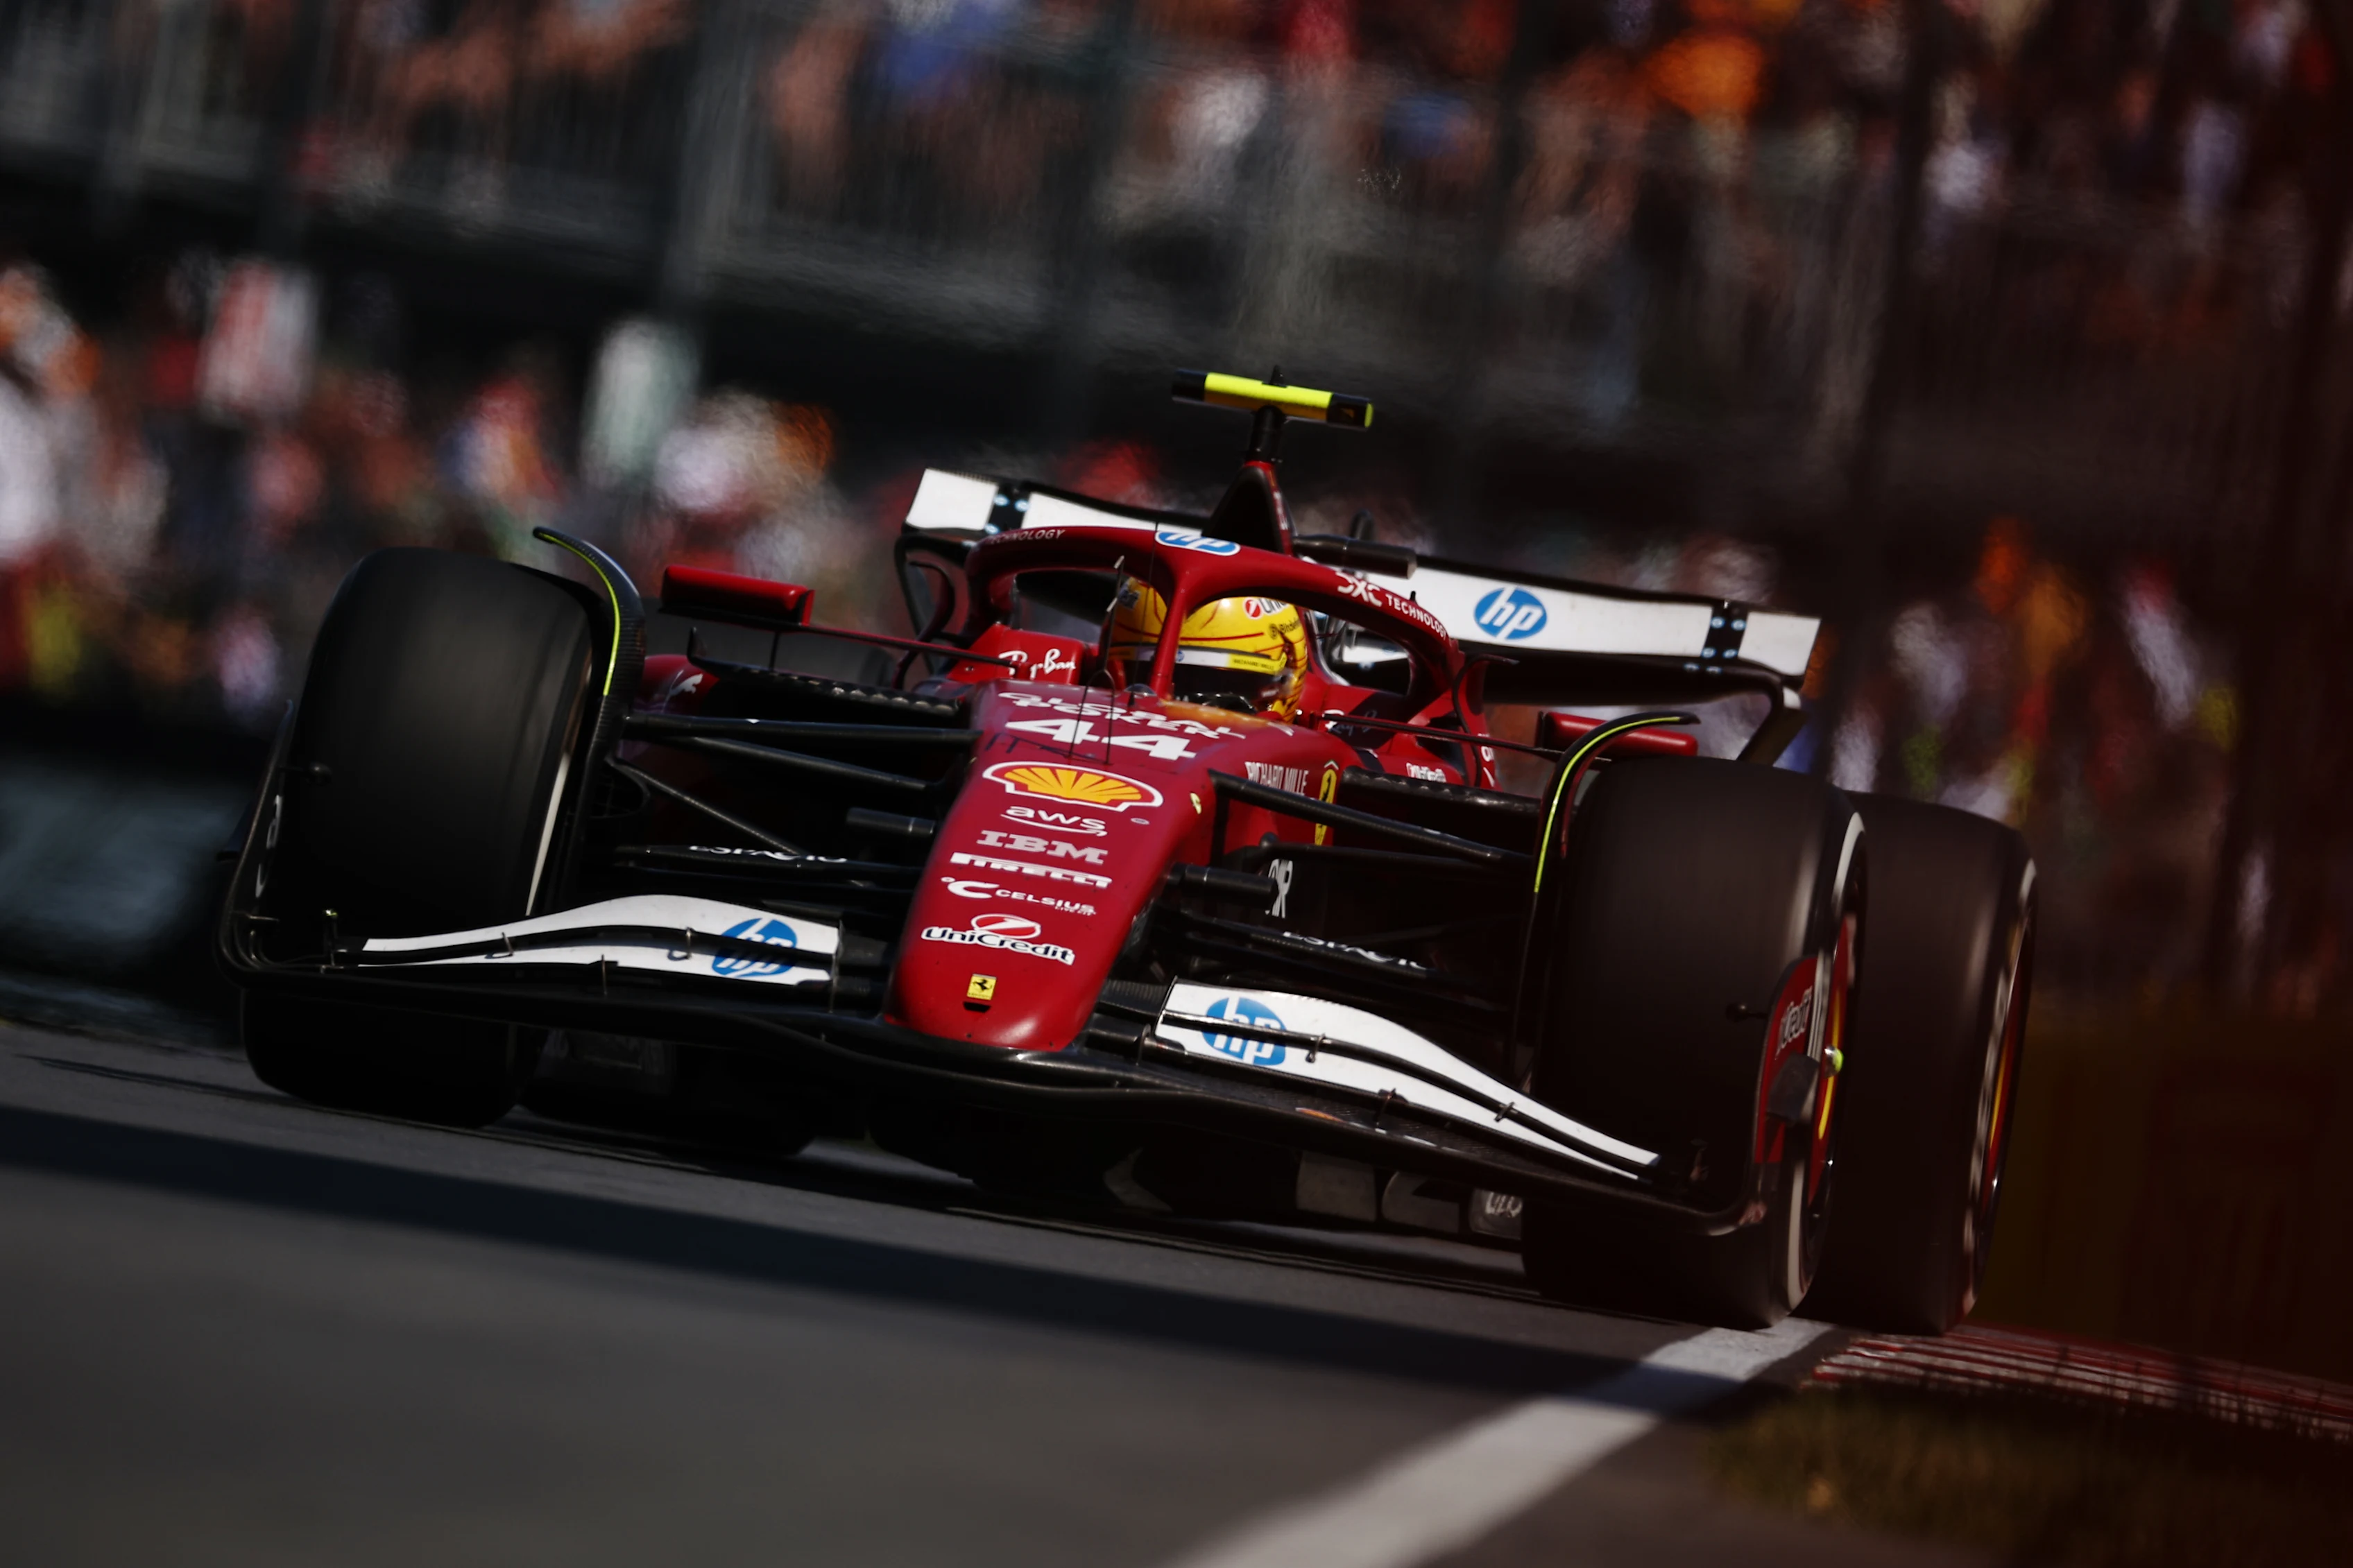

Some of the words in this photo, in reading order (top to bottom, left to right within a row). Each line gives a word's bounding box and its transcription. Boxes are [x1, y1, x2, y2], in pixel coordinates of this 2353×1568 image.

[1385, 593, 1447, 641] TECHNOLOGY
[1478, 585, 1544, 639] hp
[1004, 718, 1198, 761] 44
[1005, 806, 1106, 830] aws
[976, 830, 1109, 865] IBM
[950, 852, 1113, 888] PIRELLI
[716, 918, 795, 978] hp
[924, 927, 1074, 963] UniCredit
[1212, 997, 1282, 1065] hp
